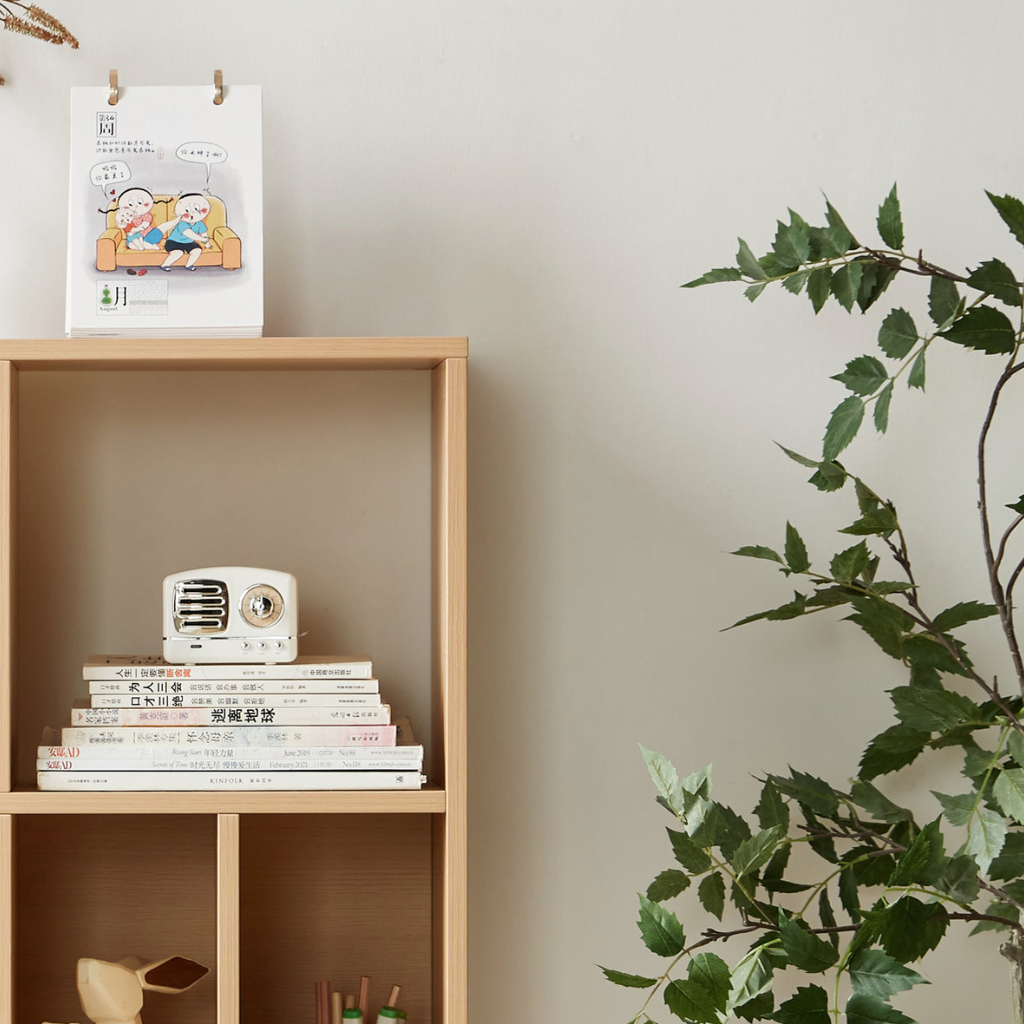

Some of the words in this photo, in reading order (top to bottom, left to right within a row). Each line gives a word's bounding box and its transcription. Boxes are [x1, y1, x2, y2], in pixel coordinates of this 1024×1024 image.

[99, 122, 114, 135] 周
[128, 682, 182, 693] 为人三会
[130, 695, 184, 707] 口才三绝
[211, 707, 276, 723] 逃离地球
[186, 731, 234, 744] 怀念母亲
[48, 746, 80, 758] 安邸AD
[204, 748, 234, 758] 年轻力量
[46, 760, 73, 769] 安邸AD
